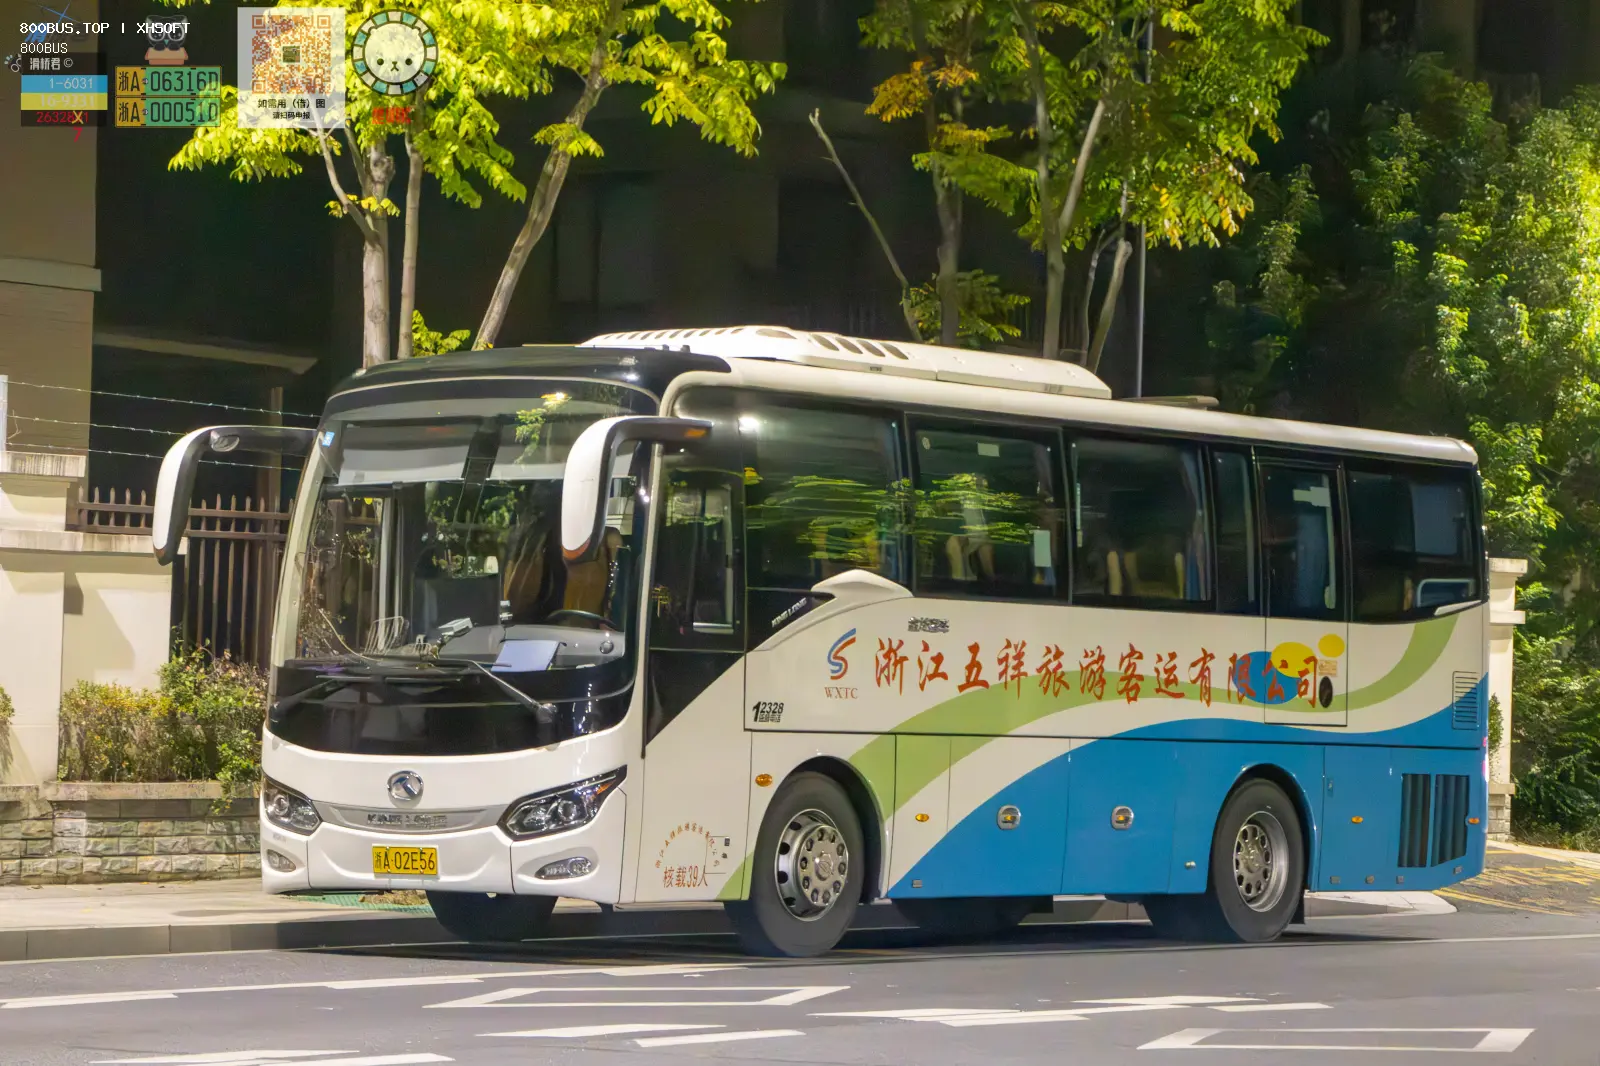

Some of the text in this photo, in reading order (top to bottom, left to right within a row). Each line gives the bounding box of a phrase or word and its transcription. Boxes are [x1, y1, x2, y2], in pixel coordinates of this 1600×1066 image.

[875, 637, 1319, 708] 浙江五祥旅游客运有限公司
[824, 686, 859, 700] WXTC
[752, 701, 785, 723] 12328
[663, 865, 709, 888] 核载39人
